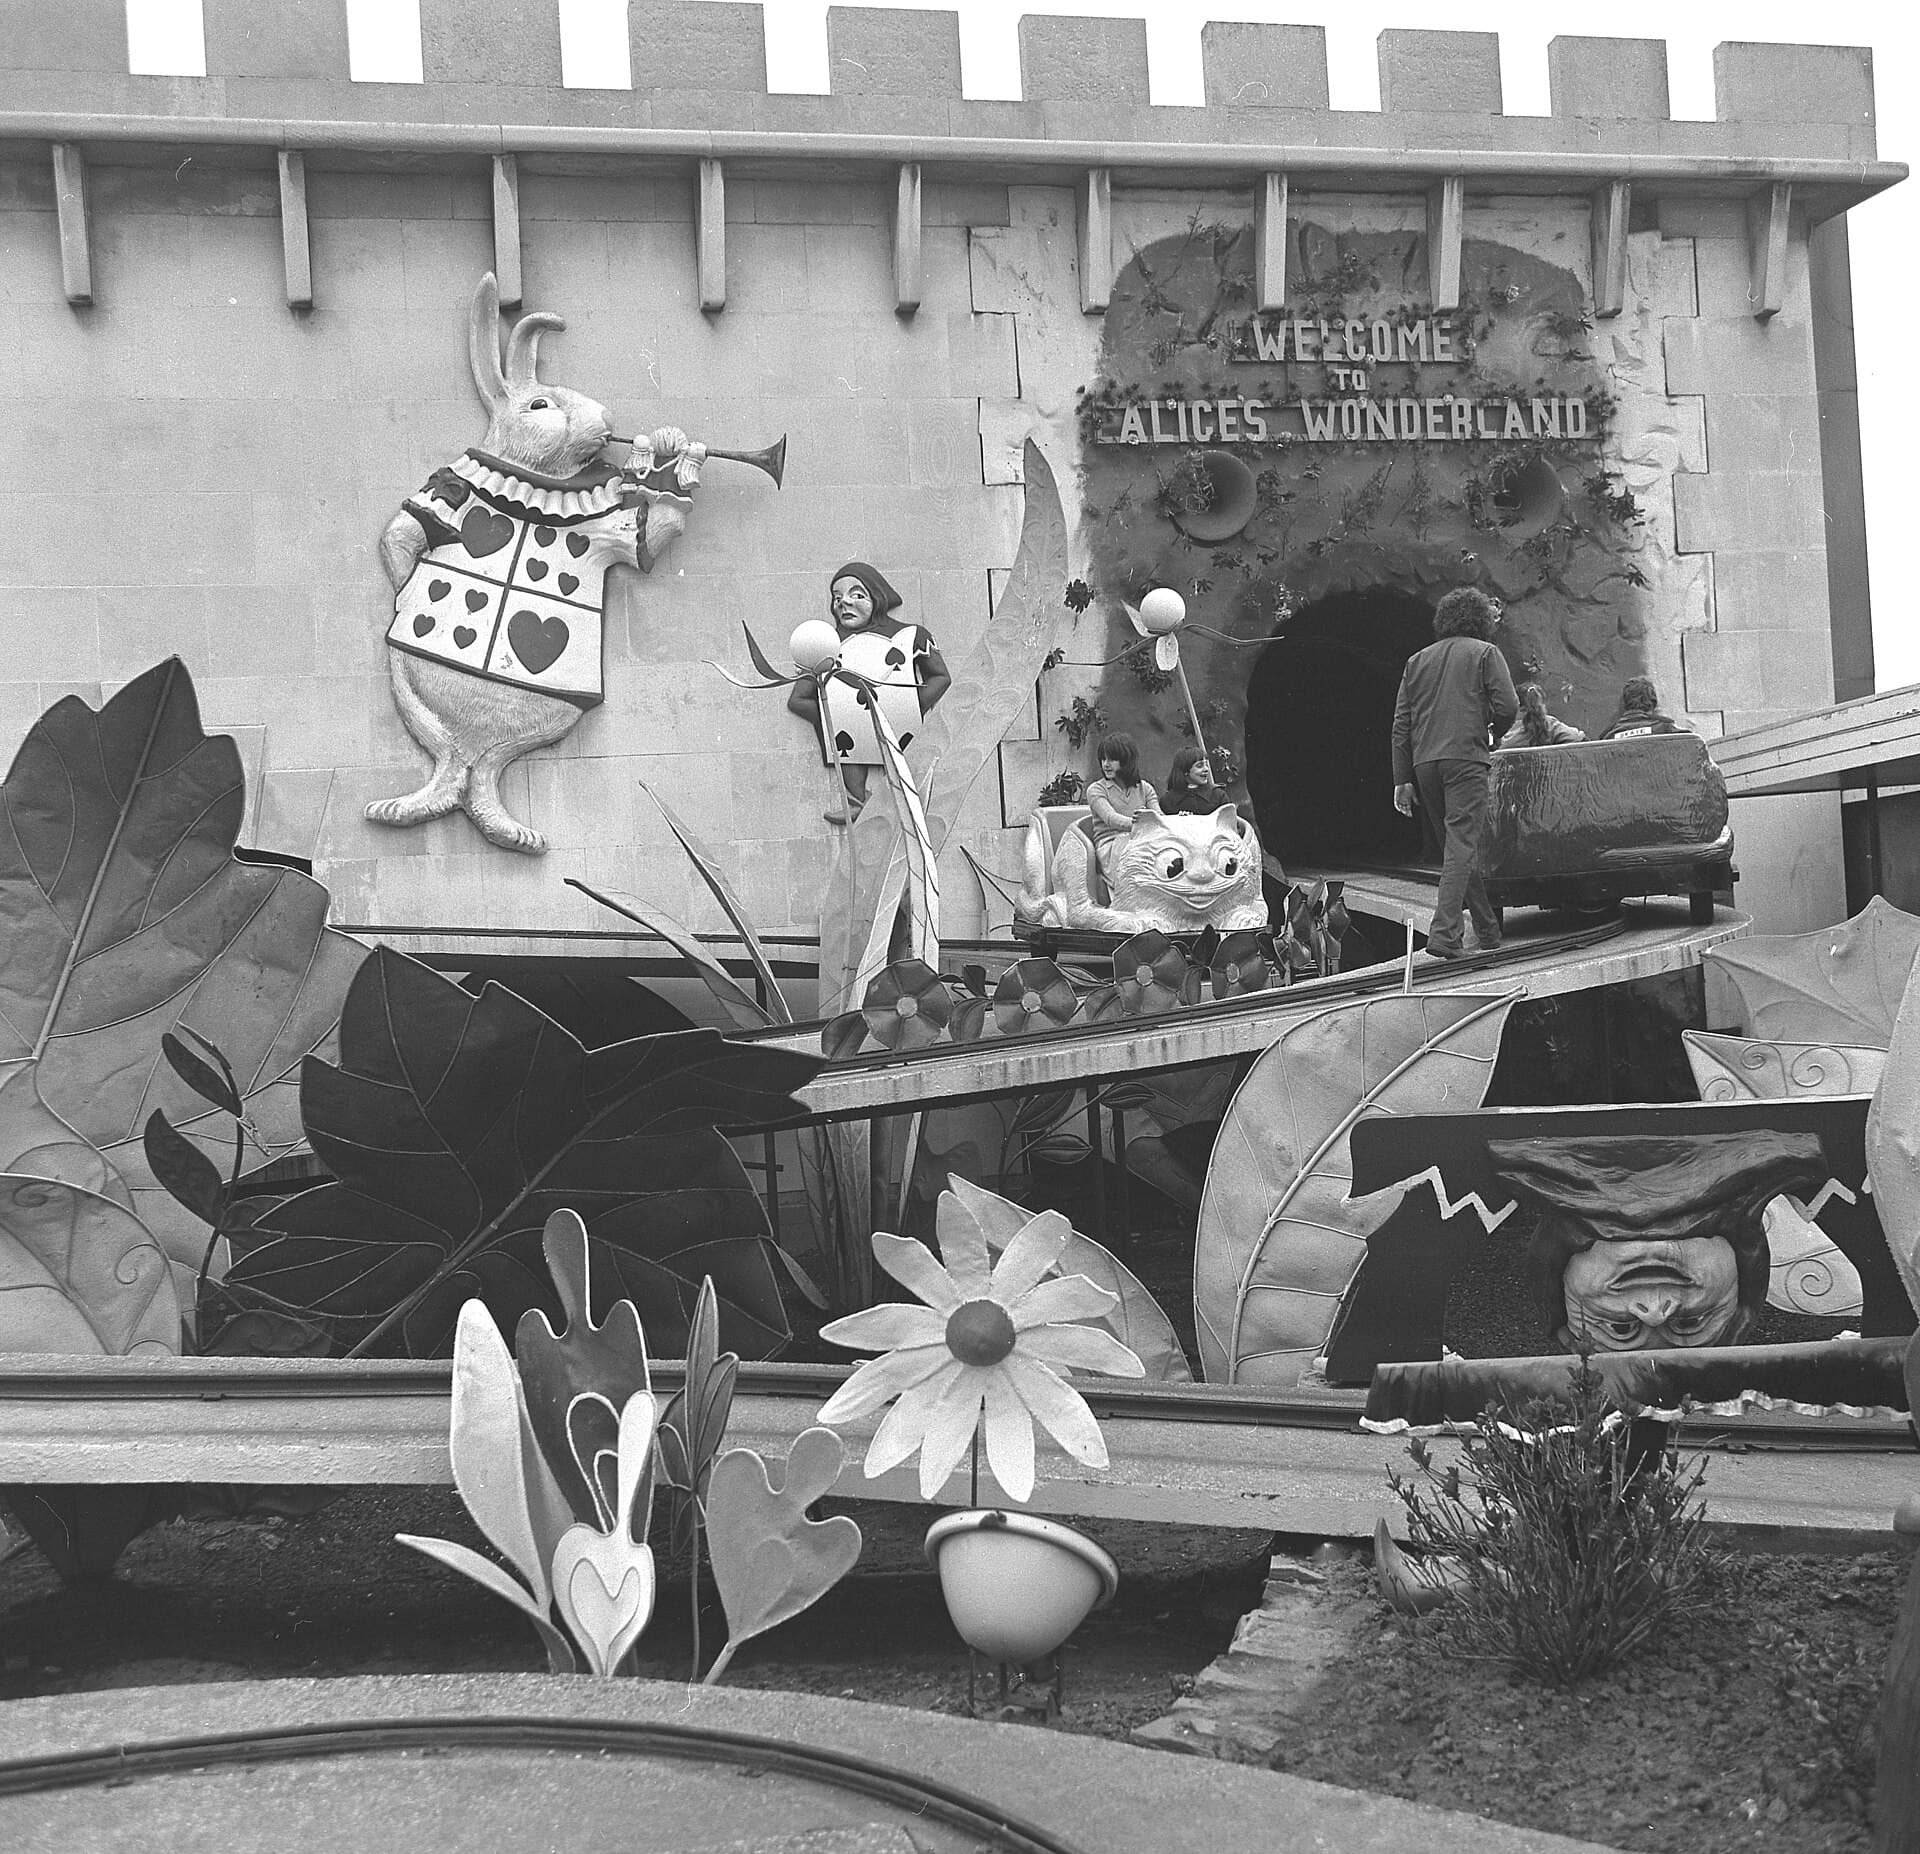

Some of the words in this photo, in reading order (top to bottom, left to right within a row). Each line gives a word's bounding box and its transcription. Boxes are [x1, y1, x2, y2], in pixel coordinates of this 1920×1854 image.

[1253, 319, 1453, 362] WELCOME
[1333, 369, 1366, 391] TO
[1119, 398, 1267, 443] ALICES
[1299, 397, 1587, 441] WONDERLAND
